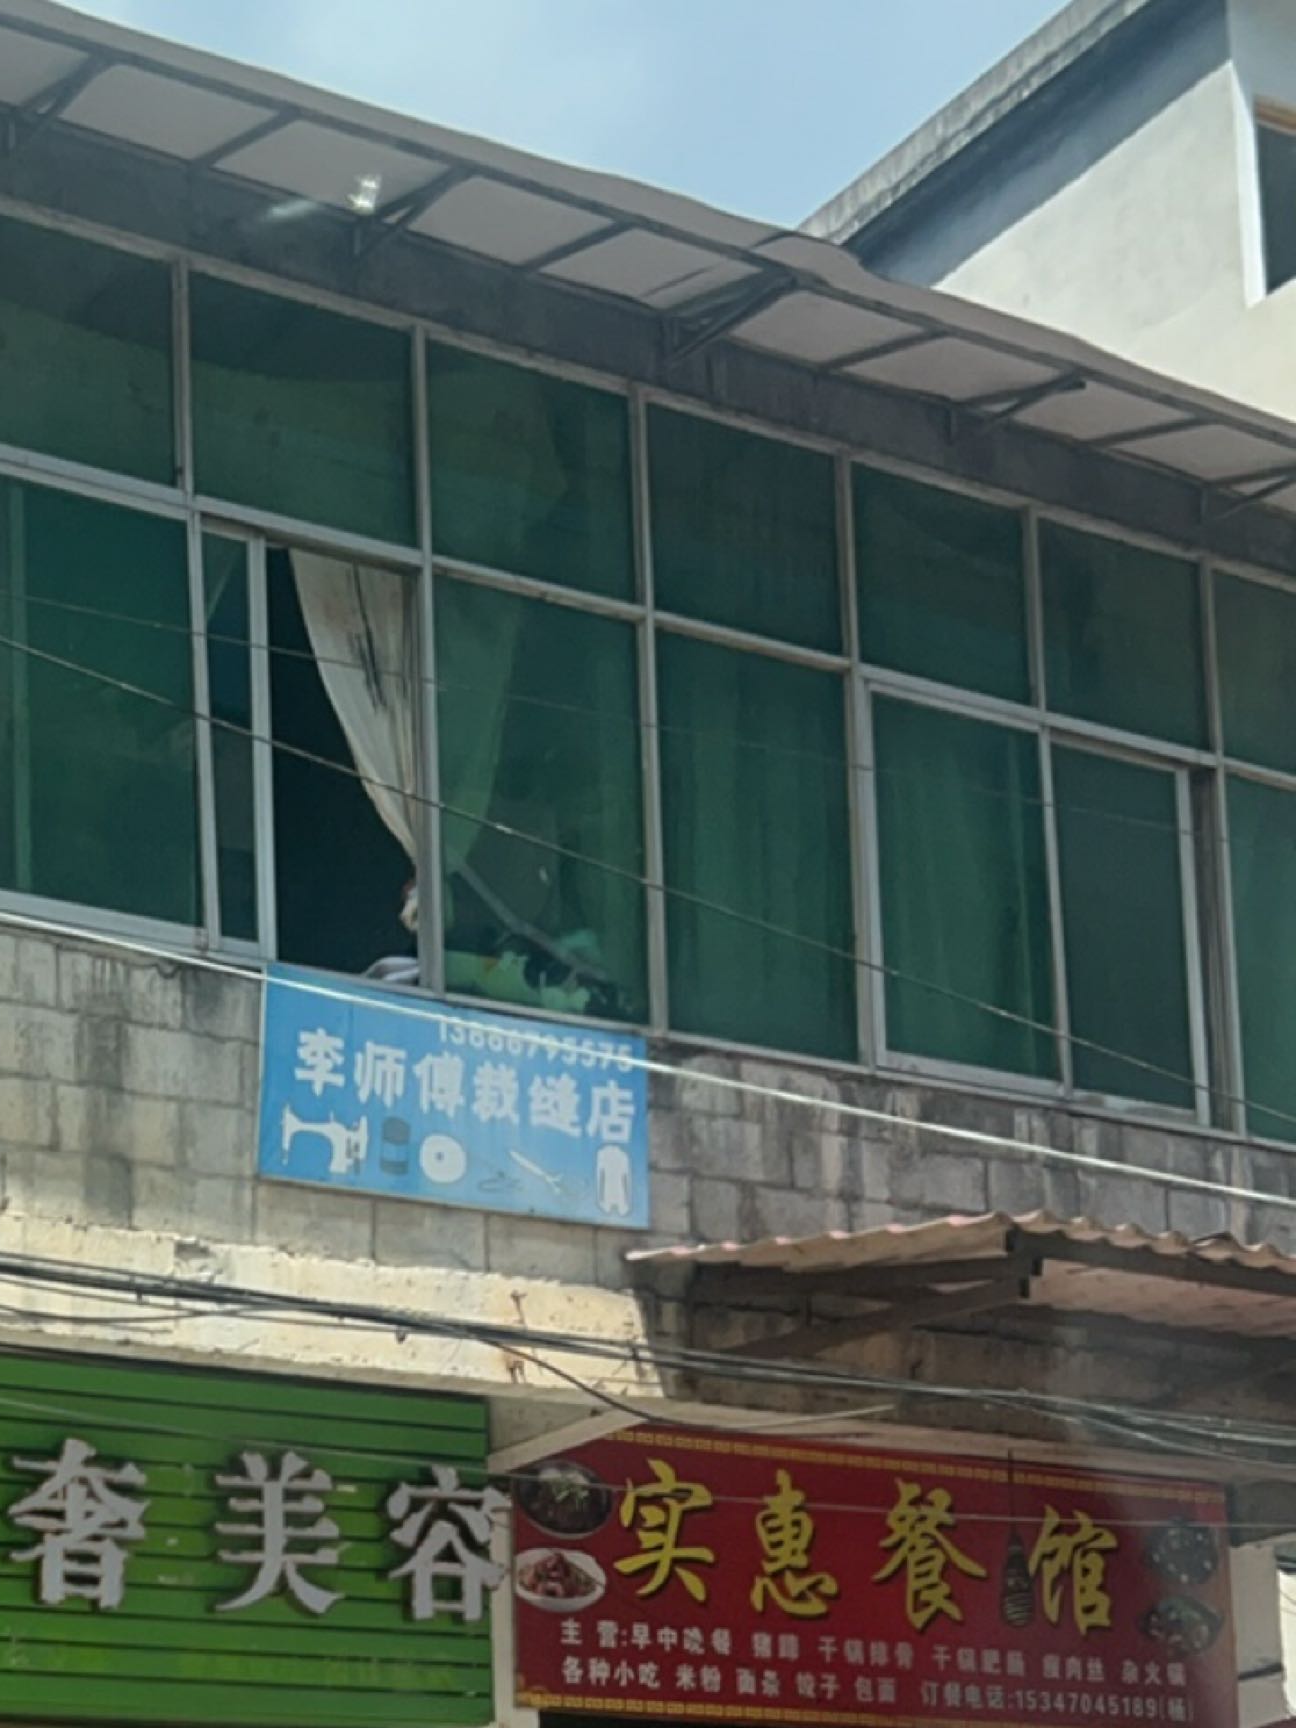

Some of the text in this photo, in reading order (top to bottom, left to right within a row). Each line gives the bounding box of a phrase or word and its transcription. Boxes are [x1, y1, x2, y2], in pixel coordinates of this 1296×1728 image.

[294, 1027, 636, 1144] 李师傅裁缝店
[613, 1458, 1121, 1637] 实惠餐馆
[562, 1654, 662, 1690] 各种小吃
[674, 1662, 722, 1693] 米粉
